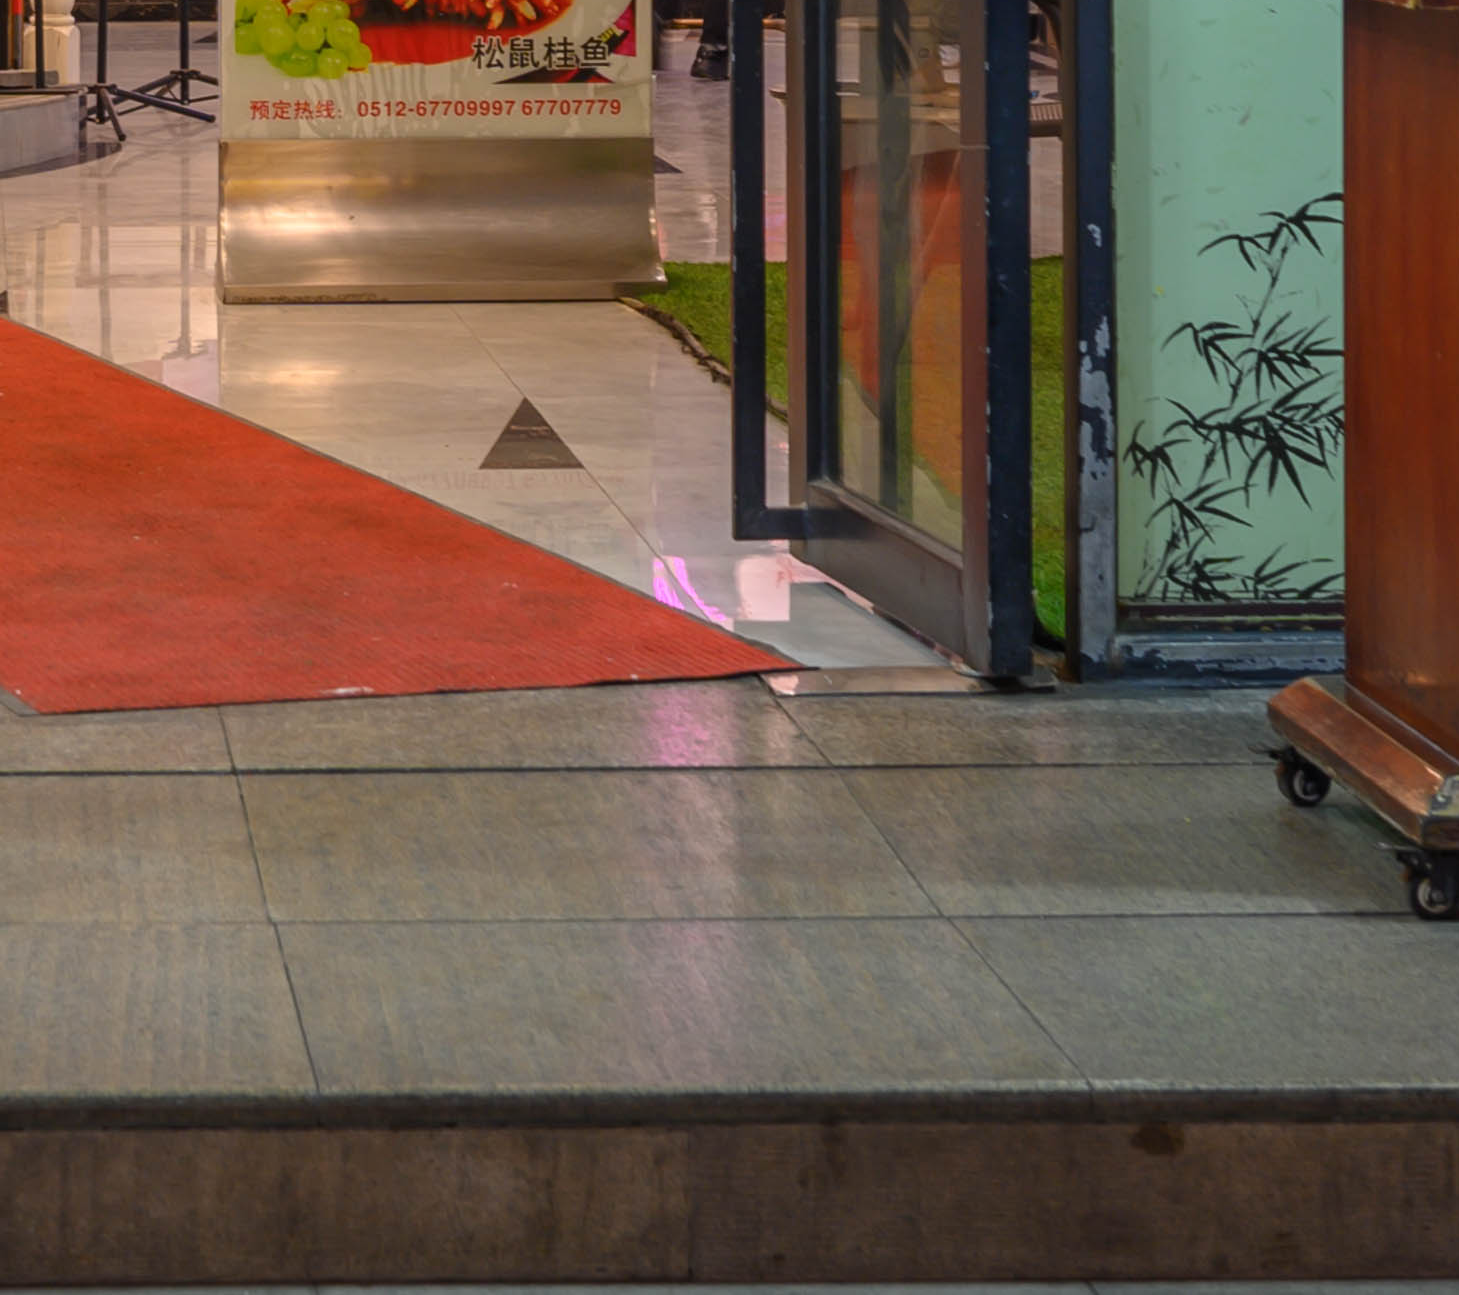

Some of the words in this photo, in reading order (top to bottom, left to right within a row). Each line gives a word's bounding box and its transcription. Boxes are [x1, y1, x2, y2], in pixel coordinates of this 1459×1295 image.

[472, 36, 611, 72] 松鼠桂鱼
[357, 98, 514, 118] 0512-67709997
[522, 98, 622, 117] 67707779
